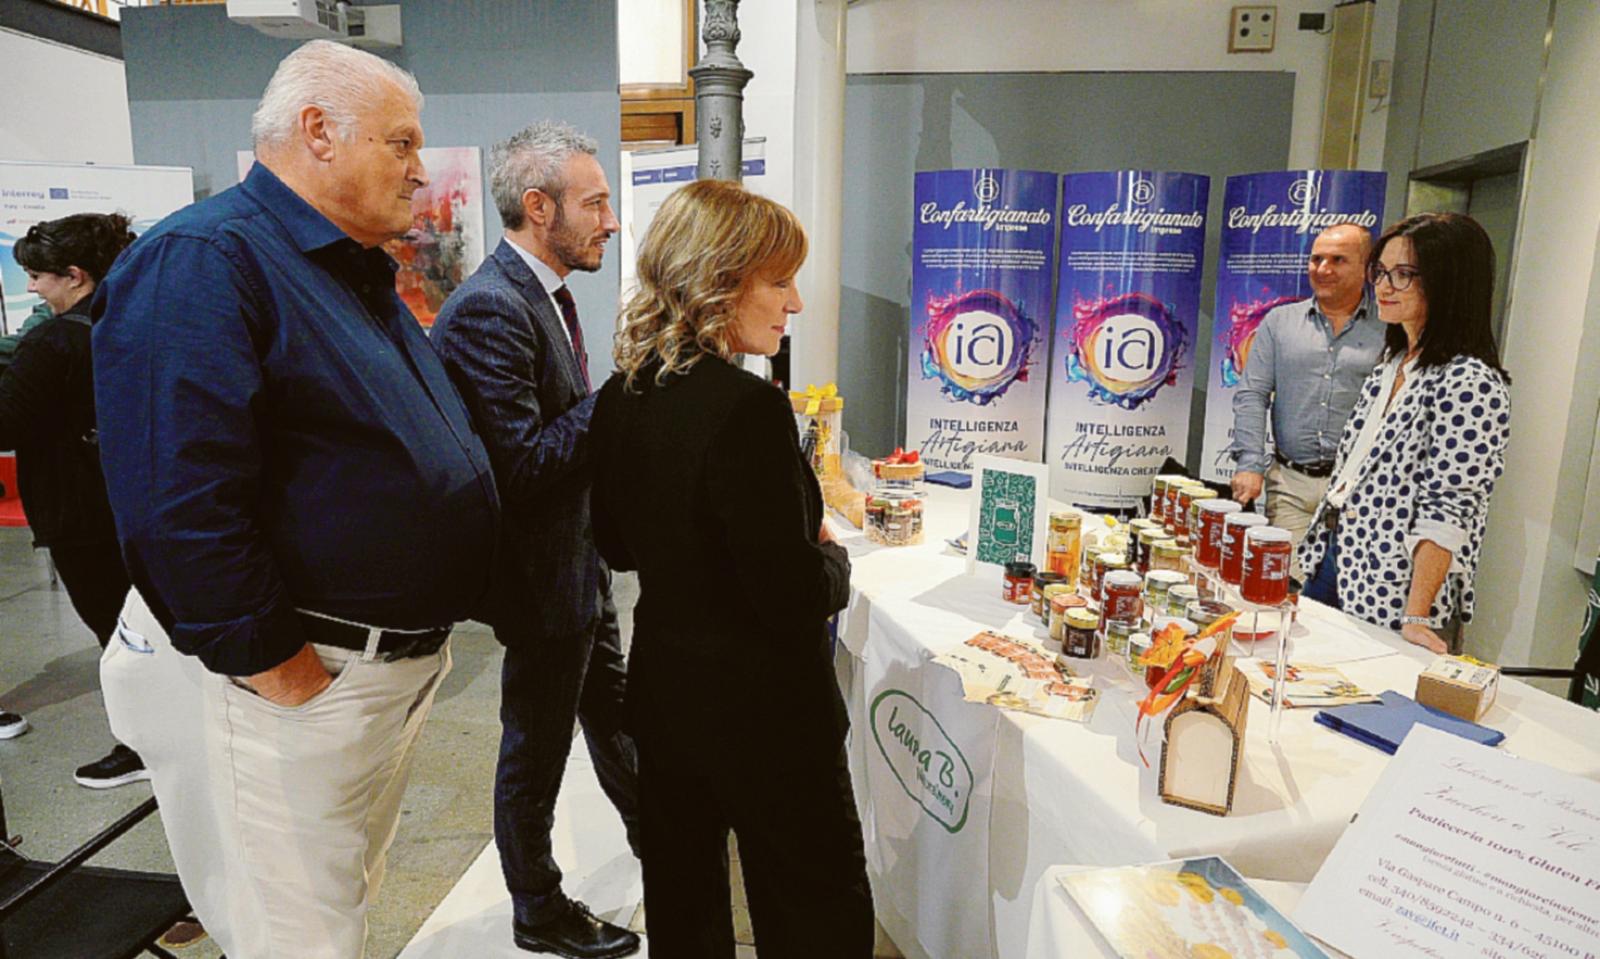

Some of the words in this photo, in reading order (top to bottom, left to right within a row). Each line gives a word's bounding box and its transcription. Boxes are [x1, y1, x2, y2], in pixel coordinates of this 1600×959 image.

[921, 201, 1051, 231] Confartigianato
[1068, 203, 1204, 233] Confartigianato
[1228, 204, 1377, 234] Confartigianato
[930, 418, 1018, 432] INTELLIGENZA
[1076, 422, 1166, 437] INTELLIGENZA
[920, 430, 1028, 463] Artigiana
[1061, 434, 1173, 466] Artigiana
[1064, 462, 1130, 475] INTELLIGENZA
[888, 706, 932, 772] Laura
[936, 750, 959, 798] B.
[1408, 806, 1484, 845] Pasticceria
[1487, 840, 1525, 860] 100%
[1528, 855, 1581, 883] Gluten
[1378, 857, 1396, 872] Via
[1397, 866, 1446, 893] Gaspare
[1446, 889, 1492, 916] Campo
[1535, 932, 1580, 957] 45100
